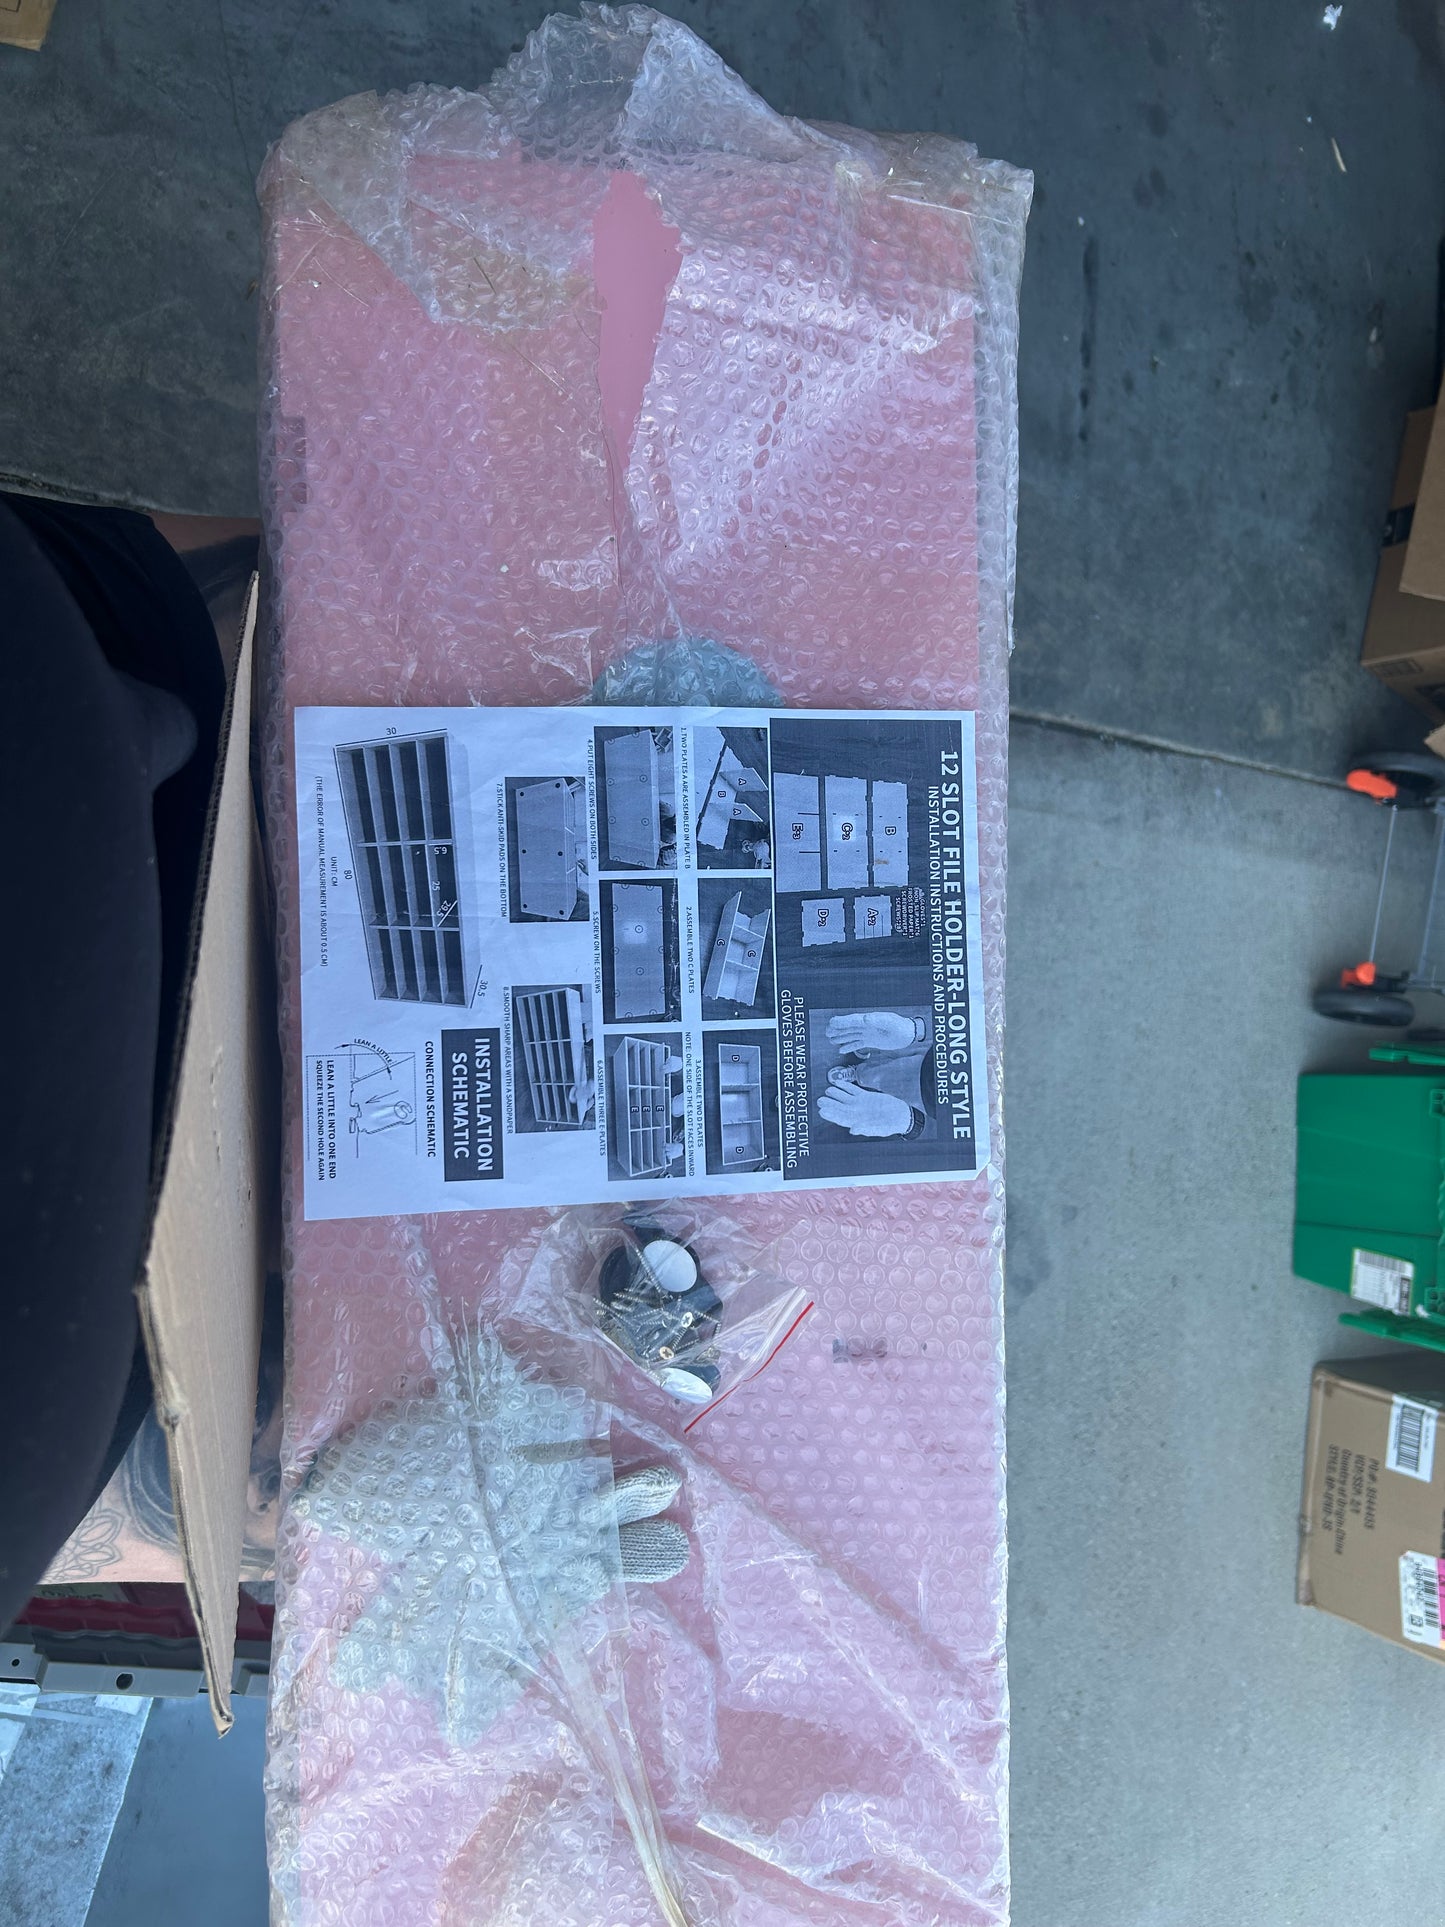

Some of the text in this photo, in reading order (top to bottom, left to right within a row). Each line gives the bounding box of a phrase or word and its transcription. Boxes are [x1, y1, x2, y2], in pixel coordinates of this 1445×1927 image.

[386, 728, 396, 736] 30
[590, 809, 596, 818] ON
[318, 818, 324, 826] OF
[885, 827, 896, 835] B
[434, 846, 448, 854] 6.5
[500, 863, 506, 872] ON
[344, 870, 352, 880] 80
[331, 877, 338, 886] CM
[432, 881, 440, 890] 25
[436, 900, 450, 917] 29.5
[594, 941, 600, 950] ON
[928, 786, 948, 1104] INSTALLATION INSTRUCTIONS AND PROCEDURES
[941, 751, 971, 1138] 12 SLOT FILE HOLDER-LONG STYLE
[477, 980, 488, 997] 30.5
[354, 1038, 372, 1047] LEAN
[781, 990, 797, 1168] GLOVES BEFORE ASSEMBLING
[794, 997, 809, 1156] PLEASE WEAR PROTECTIVE
[686, 1085, 693, 1094] OF
[425, 1041, 436, 1157] CONNECTION SCHEMATIC
[452, 1052, 470, 1158] SCHEMATIC
[475, 1038, 493, 1171] INSTALLATION
[1338, 1449, 1352, 1486] Country
